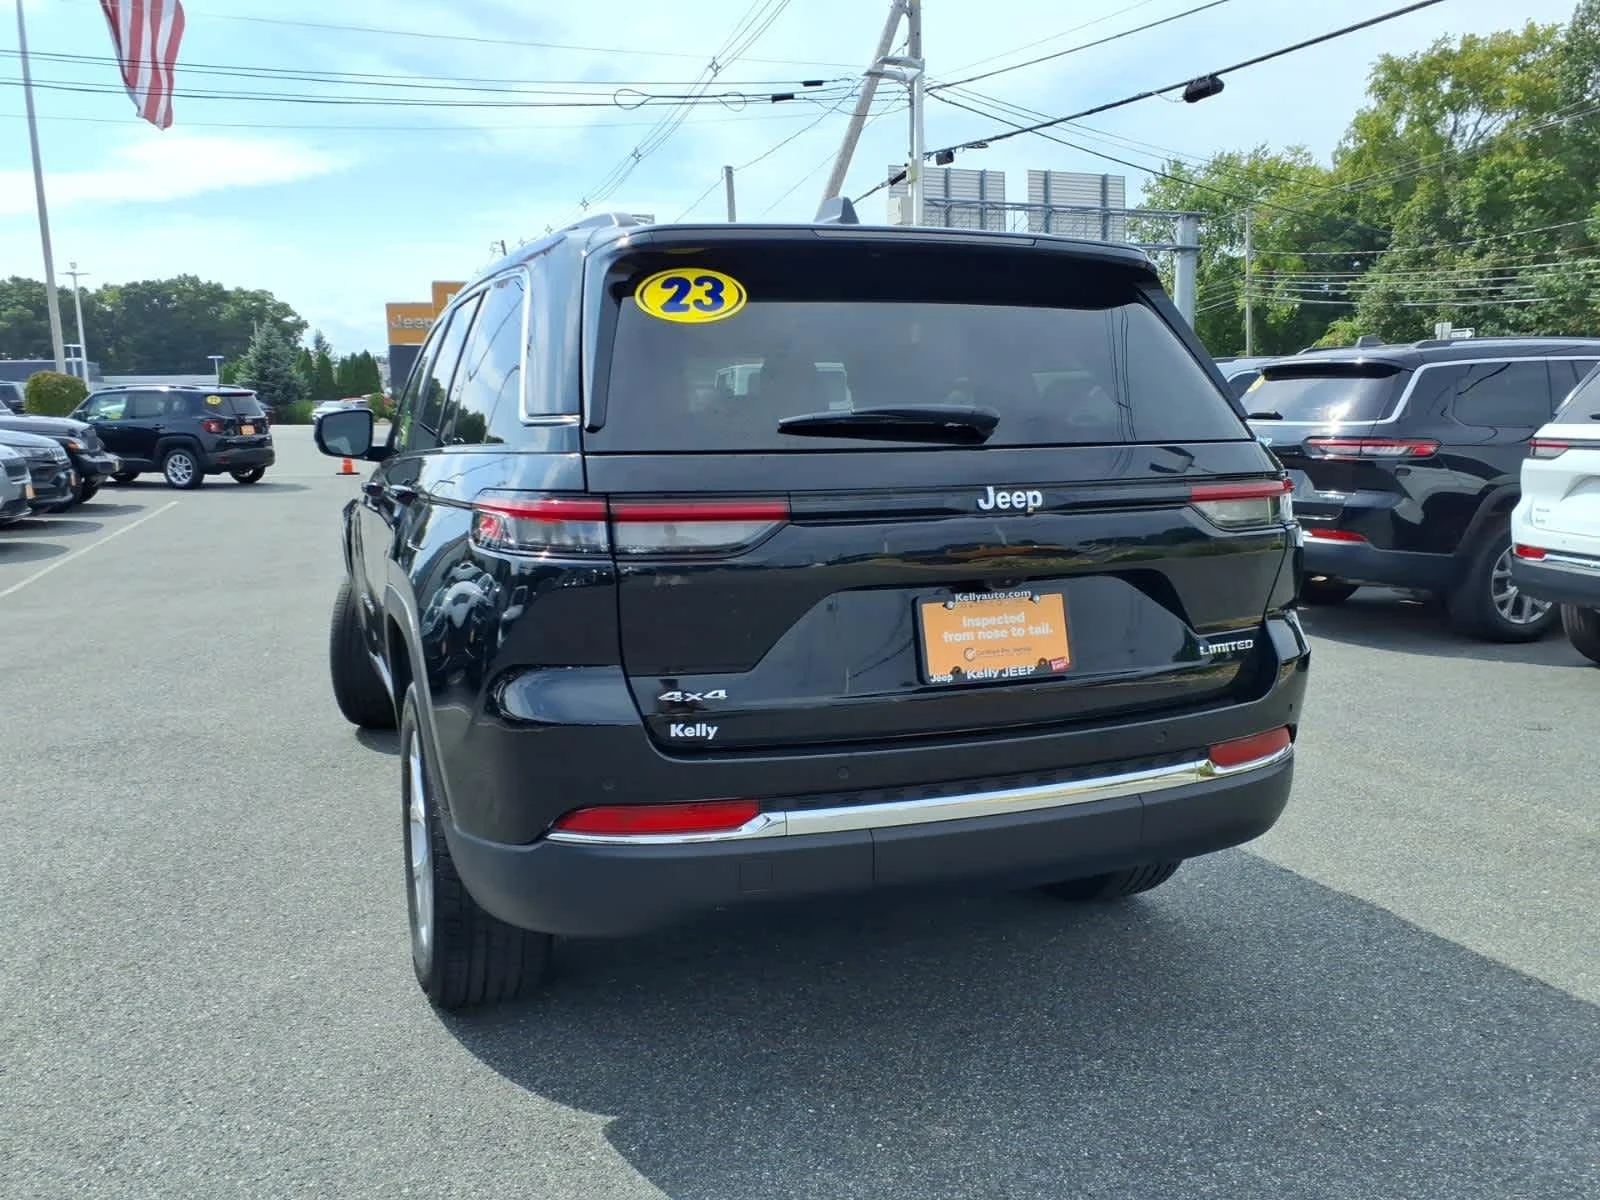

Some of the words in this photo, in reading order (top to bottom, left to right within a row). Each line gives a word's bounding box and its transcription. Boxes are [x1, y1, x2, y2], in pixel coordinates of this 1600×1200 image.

[660, 276, 725, 313] 23
[976, 486, 1043, 514] Jeep
[955, 590, 1032, 602] Kellyauto.com
[962, 612, 1025, 628] Inspected
[943, 631, 974, 643] from
[977, 629, 1008, 641] nose
[1011, 627, 1025, 638] to
[1200, 640, 1254, 655] LIMITED
[930, 674, 954, 683] Jeep
[966, 668, 999, 681] Kelly
[1001, 665, 1036, 678] JEEP
[658, 689, 728, 702] 4x4
[670, 723, 719, 740] Kelly
